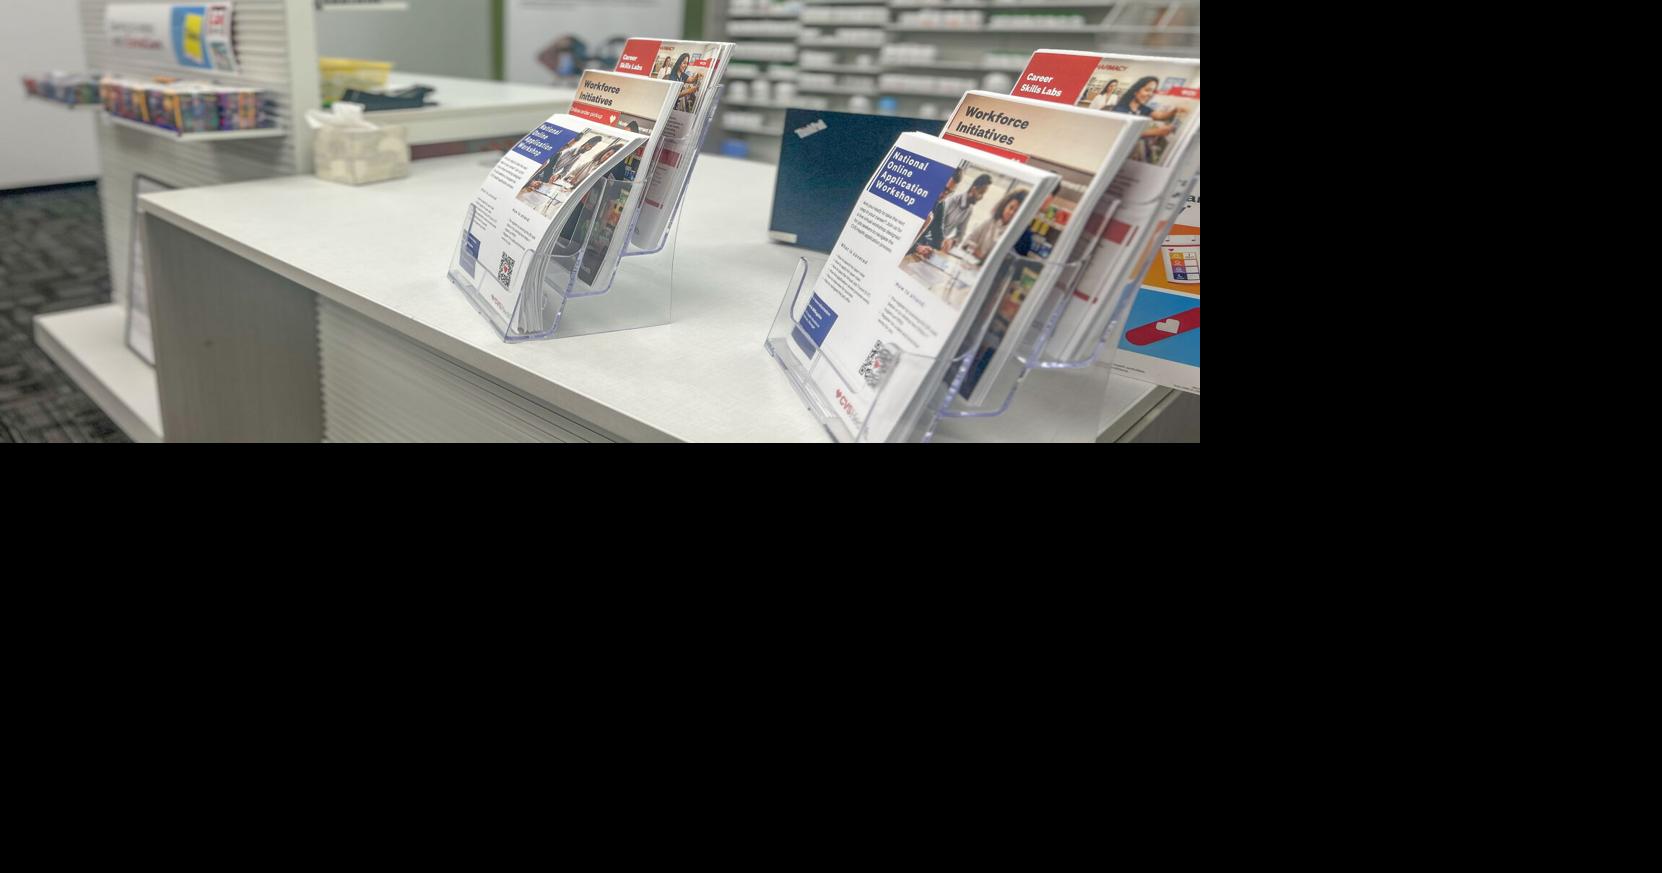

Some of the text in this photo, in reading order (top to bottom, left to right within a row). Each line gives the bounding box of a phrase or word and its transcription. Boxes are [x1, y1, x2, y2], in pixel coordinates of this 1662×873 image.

[1026, 72, 1054, 83] Career
[584, 80, 620, 94] Workforce
[1020, 84, 1062, 97] Skills Labs
[579, 92, 613, 106] Initiatives
[965, 106, 1029, 129] Workforce
[532, 130, 548, 140] Online
[540, 124, 563, 135] National
[956, 121, 1015, 146] Initiatives
[518, 142, 542, 157] Workshop
[525, 136, 553, 151] Application
[892, 151, 929, 171] National
[887, 162, 913, 178] Online
[880, 171, 929, 198] Application
[875, 181, 916, 206] Workshop
